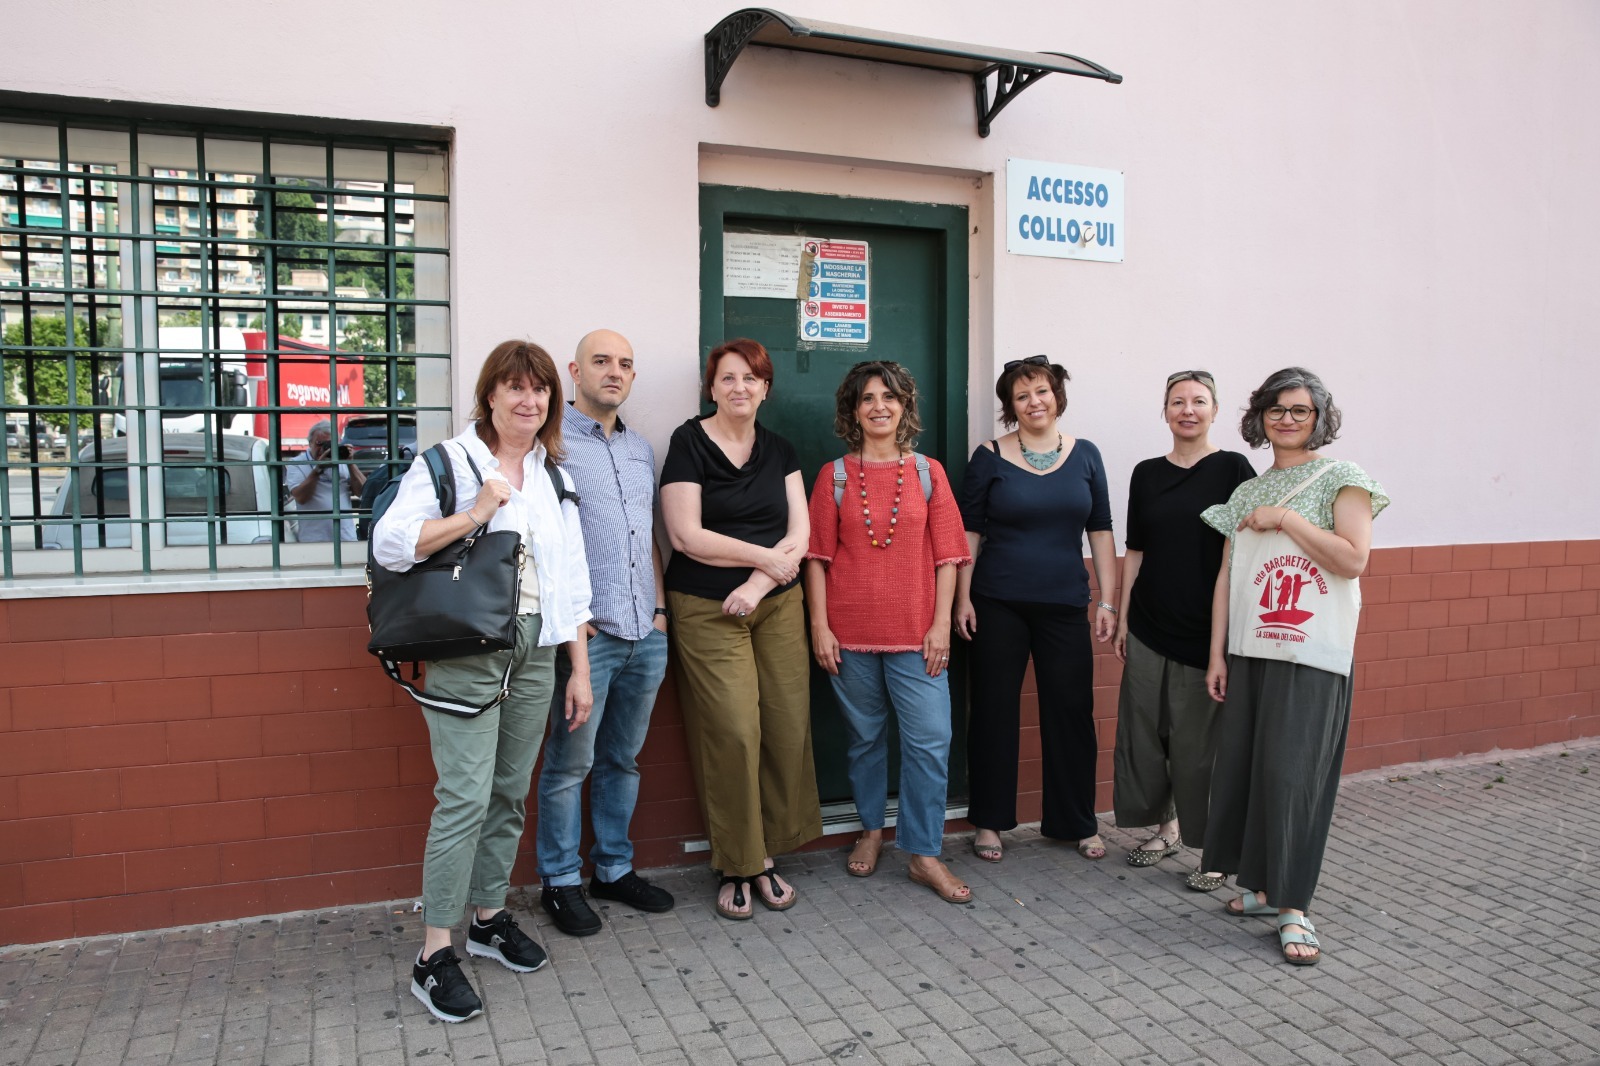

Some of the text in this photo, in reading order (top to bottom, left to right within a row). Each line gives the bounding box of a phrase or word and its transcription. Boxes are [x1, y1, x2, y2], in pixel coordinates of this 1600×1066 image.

[1027, 176, 1108, 208] ACCESSO
[1019, 214, 1114, 247] COLLOUI
[1254, 555, 1328, 595] rete BARCHETTA rossa
[1256, 630, 1306, 643] LA SEMINA DEI SOGNI
